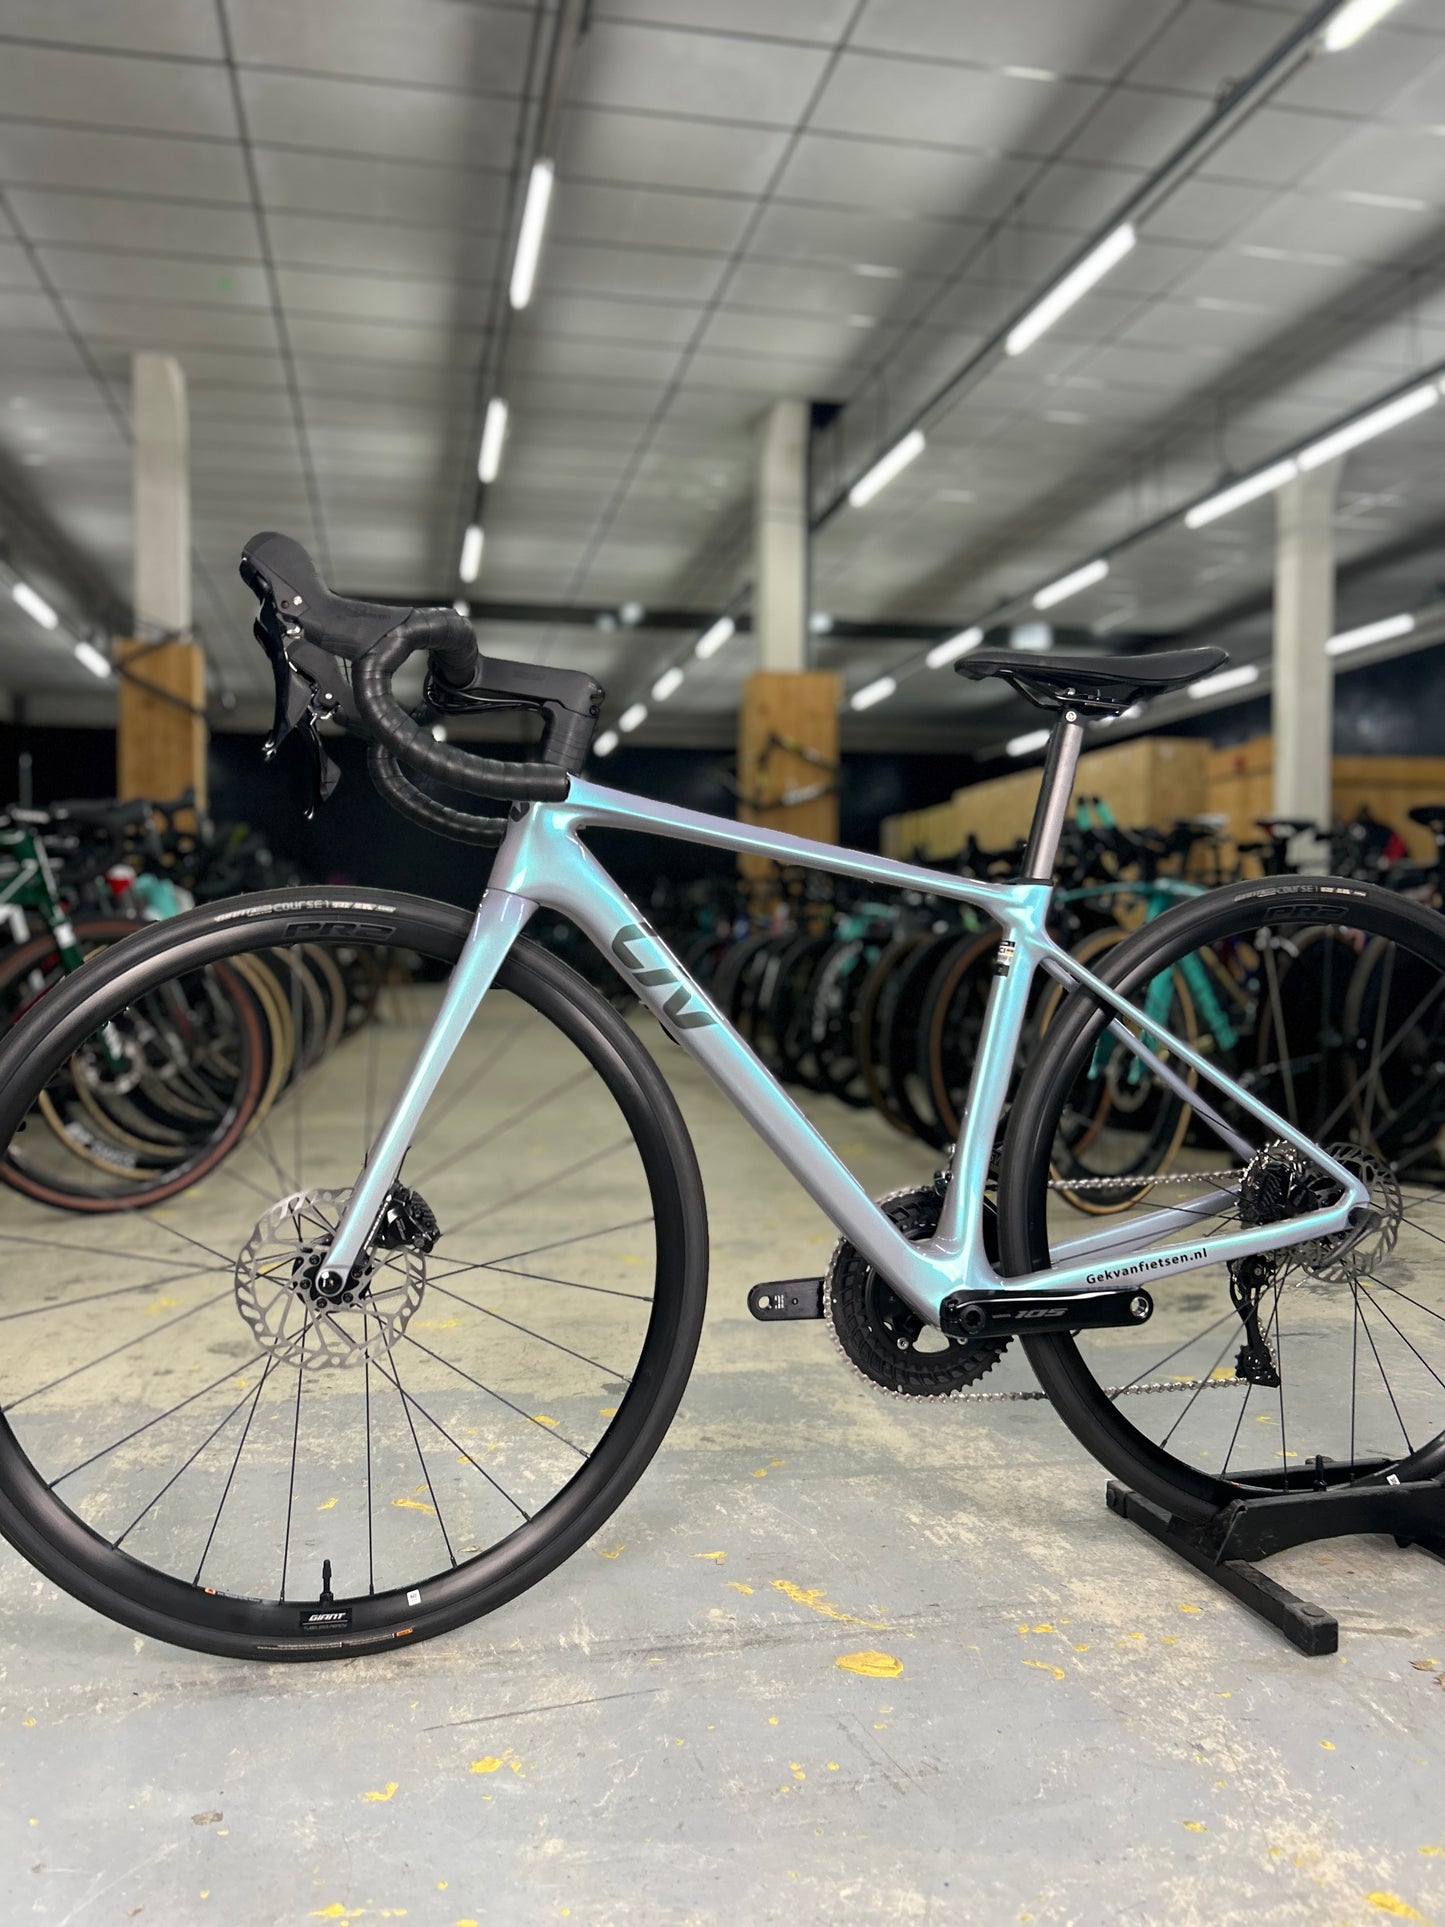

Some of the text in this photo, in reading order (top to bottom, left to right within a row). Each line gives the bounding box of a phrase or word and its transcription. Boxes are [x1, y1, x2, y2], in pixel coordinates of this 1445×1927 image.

[281, 920, 398, 941] PR2
[1086, 1247, 1208, 1284] Gekvanfietsen.nl
[1014, 1307, 1069, 1319] 105
[308, 1612, 347, 1622] GIANT
